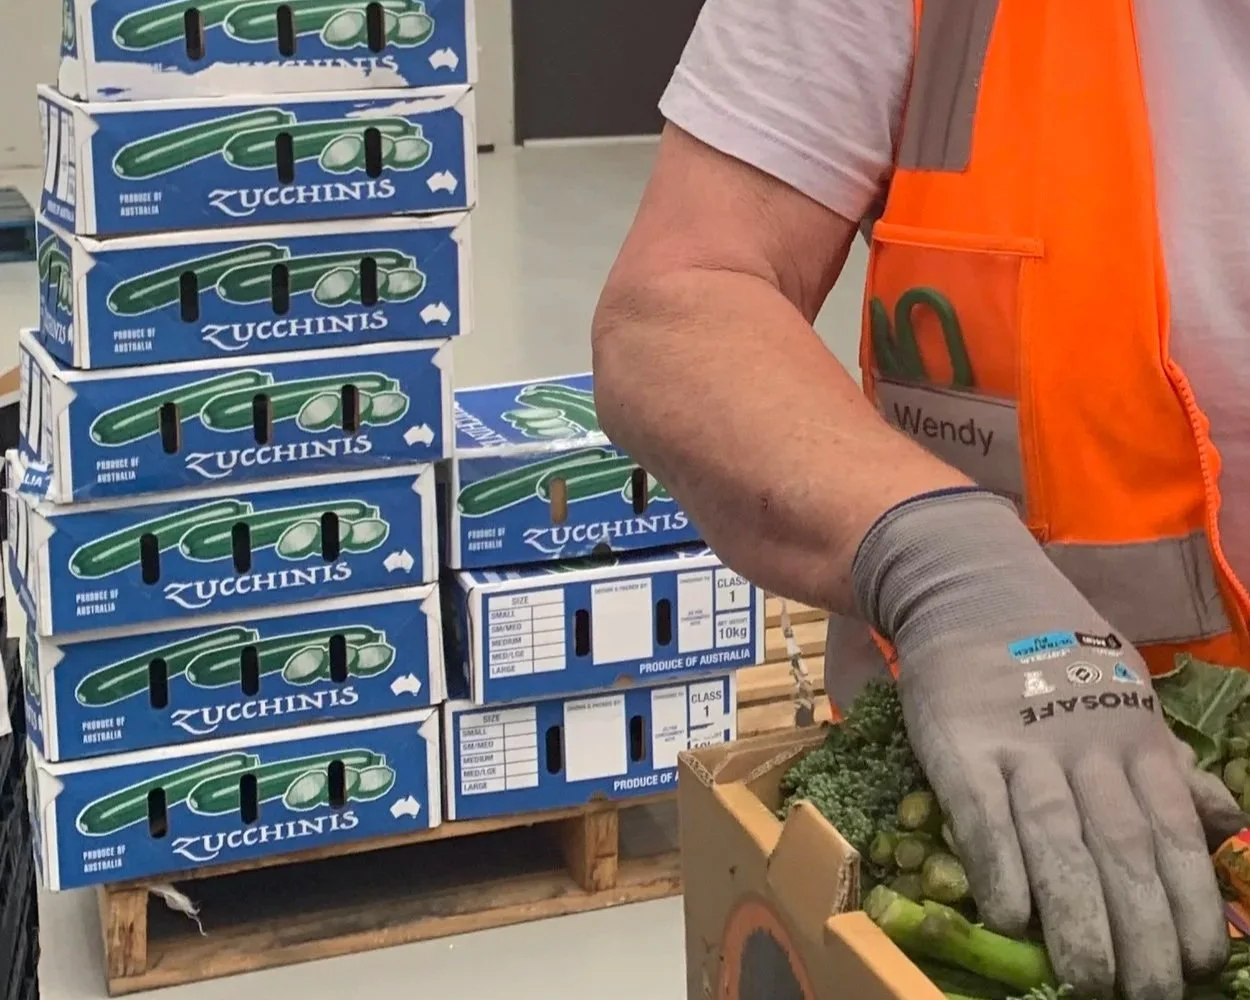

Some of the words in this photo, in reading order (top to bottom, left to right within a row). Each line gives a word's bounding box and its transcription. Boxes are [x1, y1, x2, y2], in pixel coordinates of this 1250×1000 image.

[208, 178, 396, 217] ZUCCHINIS
[120, 205, 160, 216] AUSTRALIA
[201, 311, 388, 351] ZUCCHINIS
[114, 341, 153, 353] AUSTRALIA
[893, 401, 995, 456] Wendy
[185, 434, 373, 479] ZUCCHINIS
[97, 470, 136, 483] AUSTRALIA
[522, 511, 689, 553] ZUCCHINIS
[163, 561, 352, 609] ZUCCHINIS
[717, 576, 748, 588] CLASS
[511, 596, 529, 605] SIZE
[729, 590, 736, 603] 1
[76, 602, 116, 616] AUSTRALIA
[718, 627, 748, 640] 10kg
[639, 659, 683, 674] PRODUCE
[685, 657, 698, 668] OF
[699, 648, 751, 665] AUSTRALIA
[691, 690, 722, 704] CLASS
[170, 685, 359, 735] ZUCCHINIS
[703, 705, 710, 718] 1
[1019, 691, 1156, 727] PROSAFE
[483, 714, 500, 723] SIZE
[83, 730, 122, 744] AUSTRALIA
[613, 776, 658, 791] PRODUCE
[660, 772, 673, 784] OF
[172, 810, 359, 862] ZUCCHINIS
[83, 858, 123, 873] AUSTRALIA
